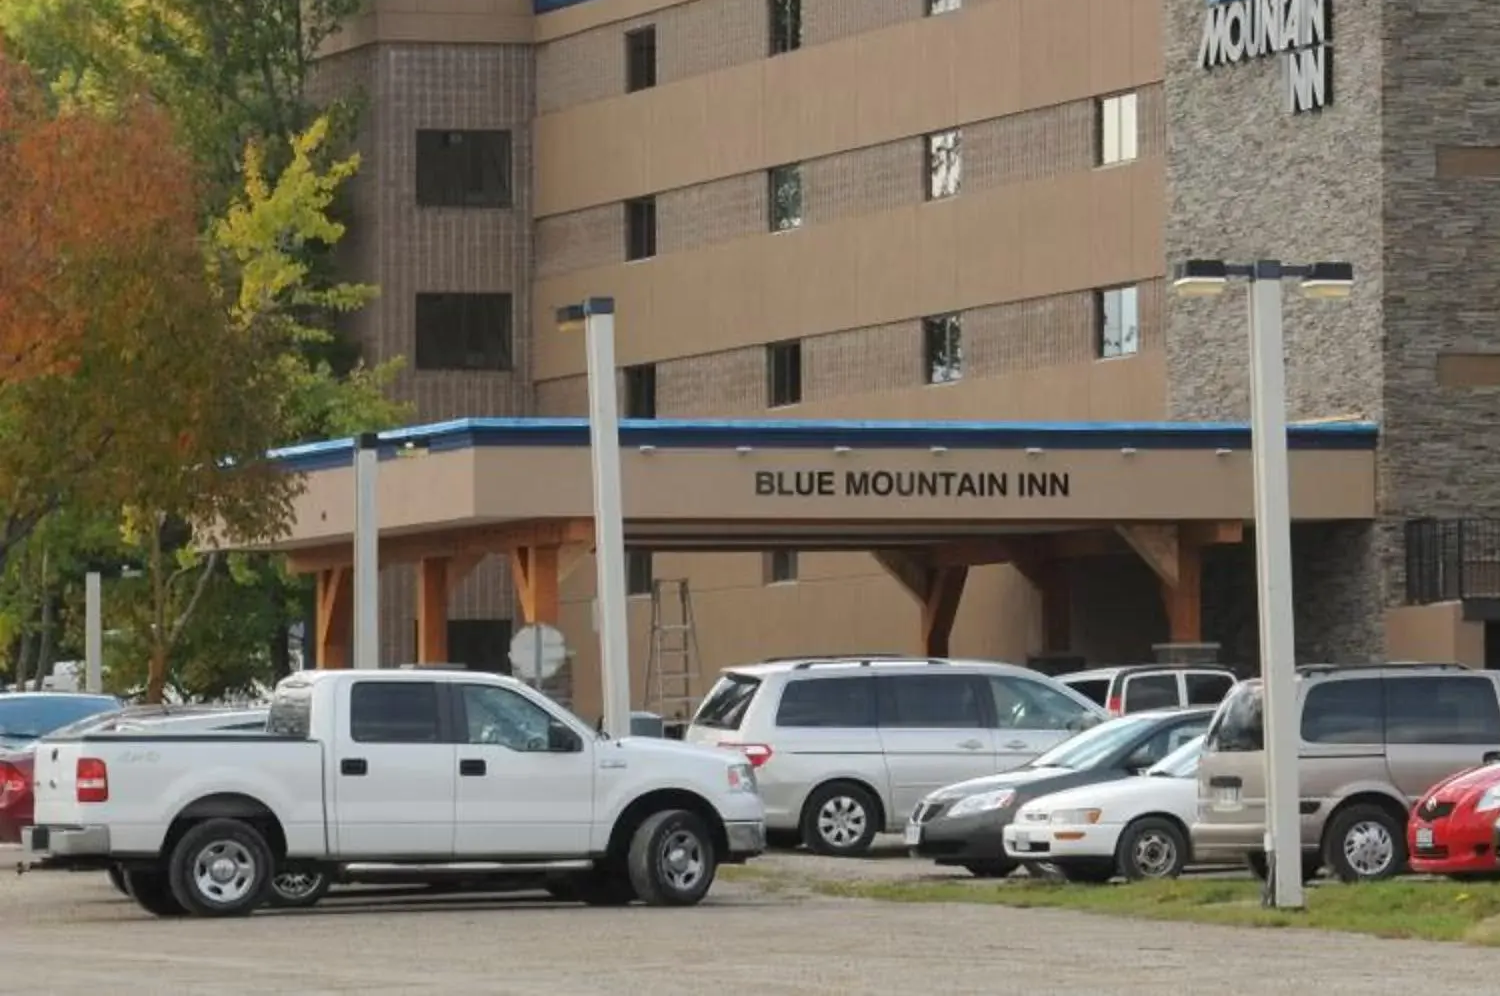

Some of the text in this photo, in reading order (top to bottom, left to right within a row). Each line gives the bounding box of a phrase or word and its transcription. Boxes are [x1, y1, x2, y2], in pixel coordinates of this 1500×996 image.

[1281, 43, 1326, 114] INN
[755, 471, 1069, 496] BLUE MOUNTAIN INN
